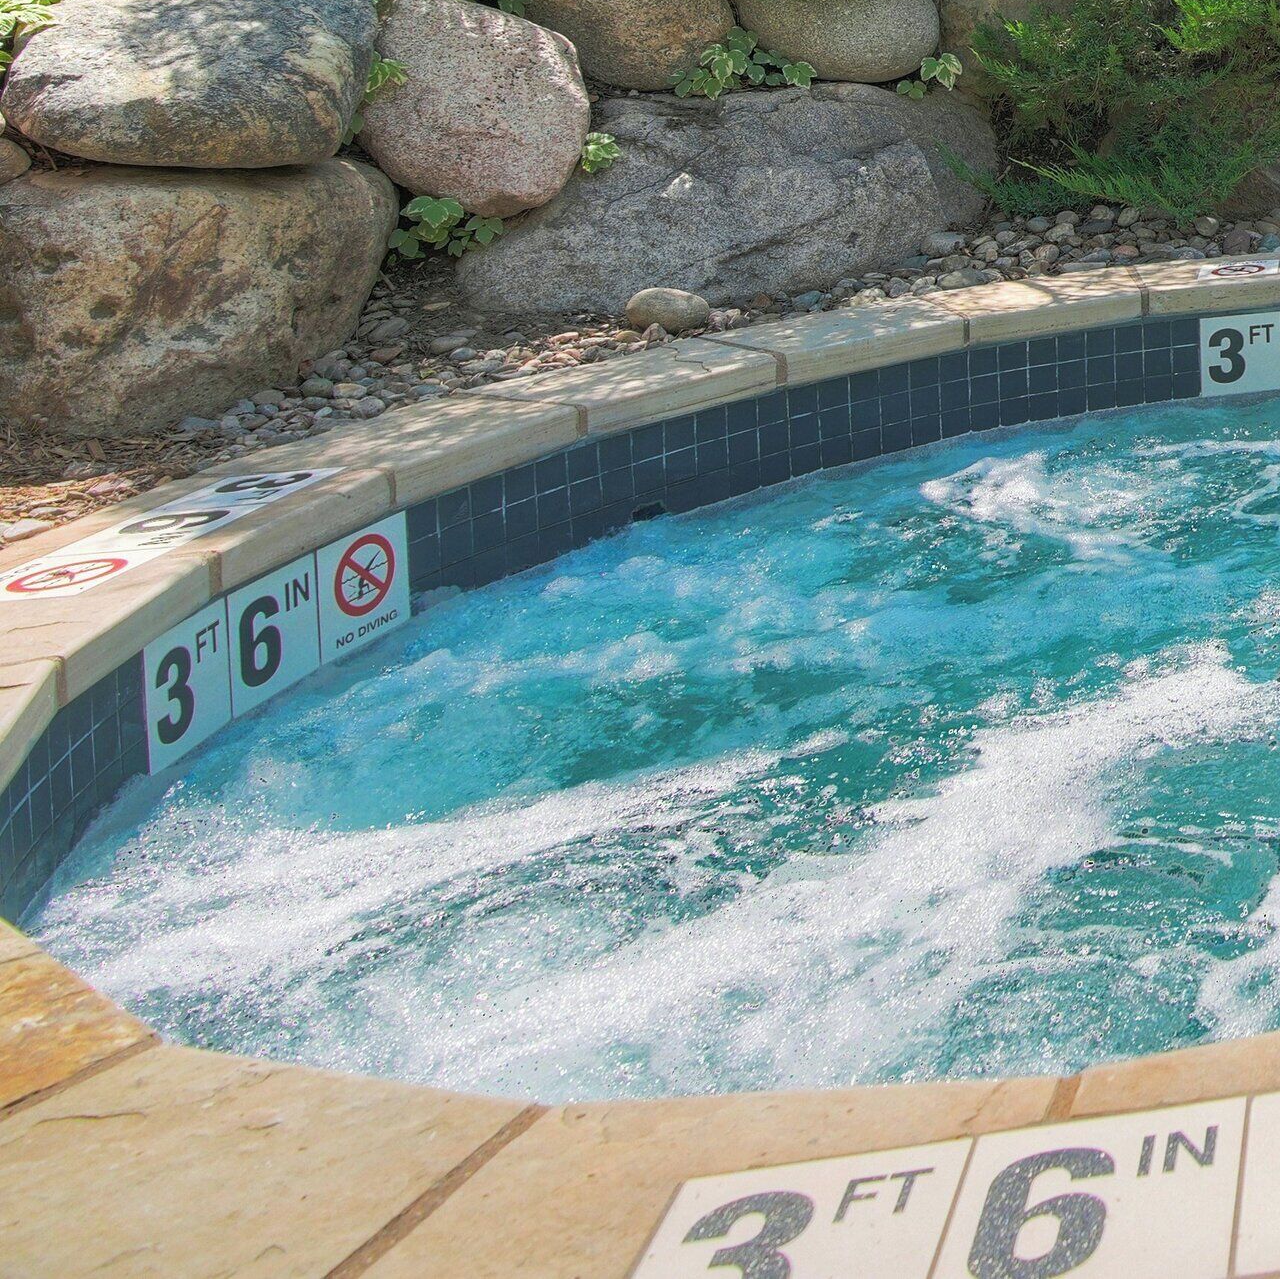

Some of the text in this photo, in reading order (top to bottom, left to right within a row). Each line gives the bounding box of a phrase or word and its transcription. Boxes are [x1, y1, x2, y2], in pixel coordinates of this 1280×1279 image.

[1208, 327, 1246, 384] 3
[1249, 323, 1274, 345] FT
[215, 472, 313, 494] 3
[118, 509, 231, 535] 6
[335, 609, 399, 649] NO DIVING
[155, 572, 310, 745] 3 FT 6 IN
[680, 1125, 1219, 1279] 3 FT 6 IN
